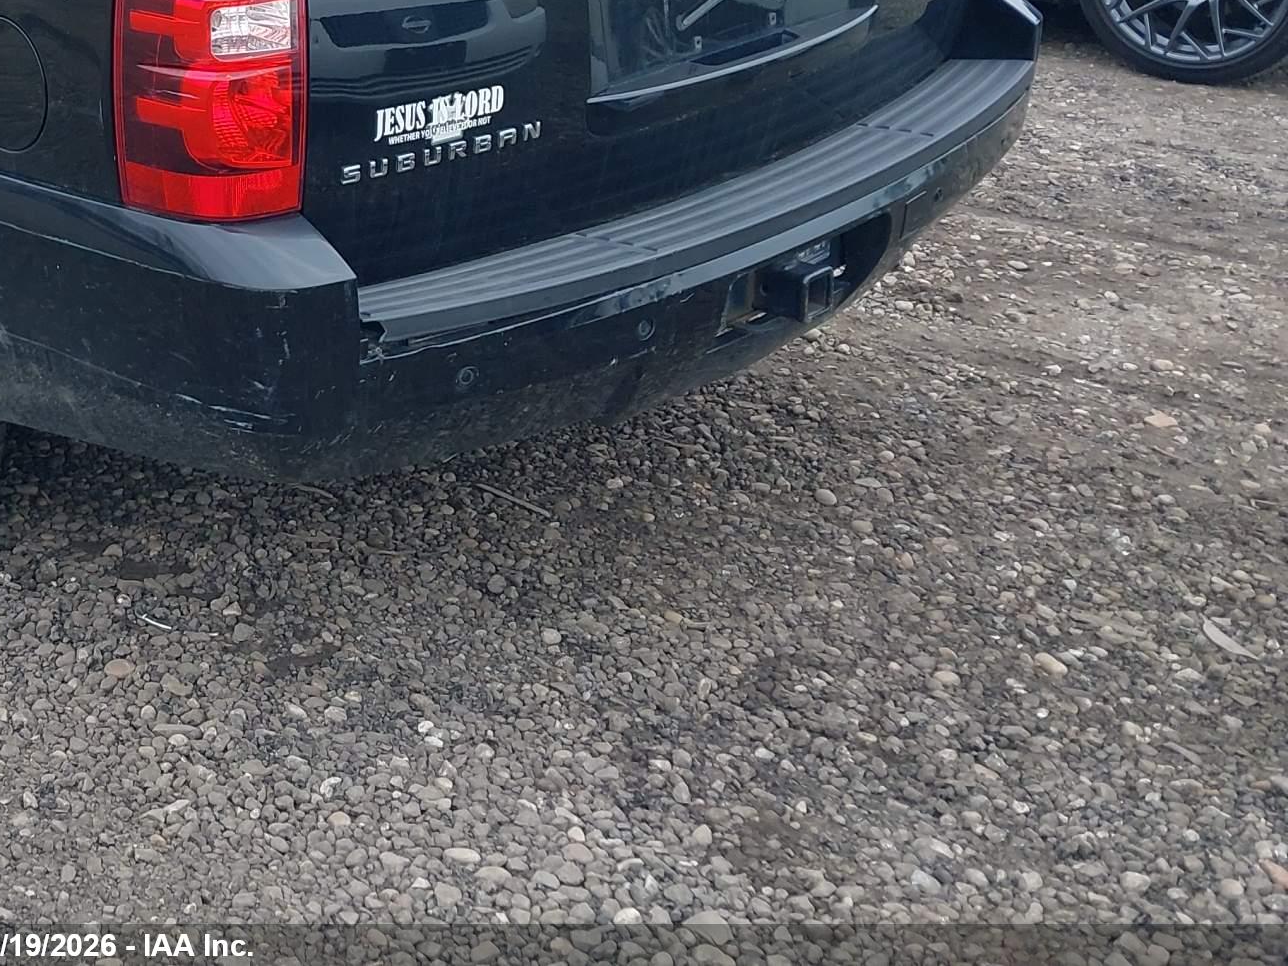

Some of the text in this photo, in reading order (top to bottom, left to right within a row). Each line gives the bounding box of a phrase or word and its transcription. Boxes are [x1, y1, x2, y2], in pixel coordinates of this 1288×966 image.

[374, 85, 504, 142] JESUS IS LORD
[388, 130, 420, 145] WHETHER
[340, 121, 542, 185] SUBURBAN
